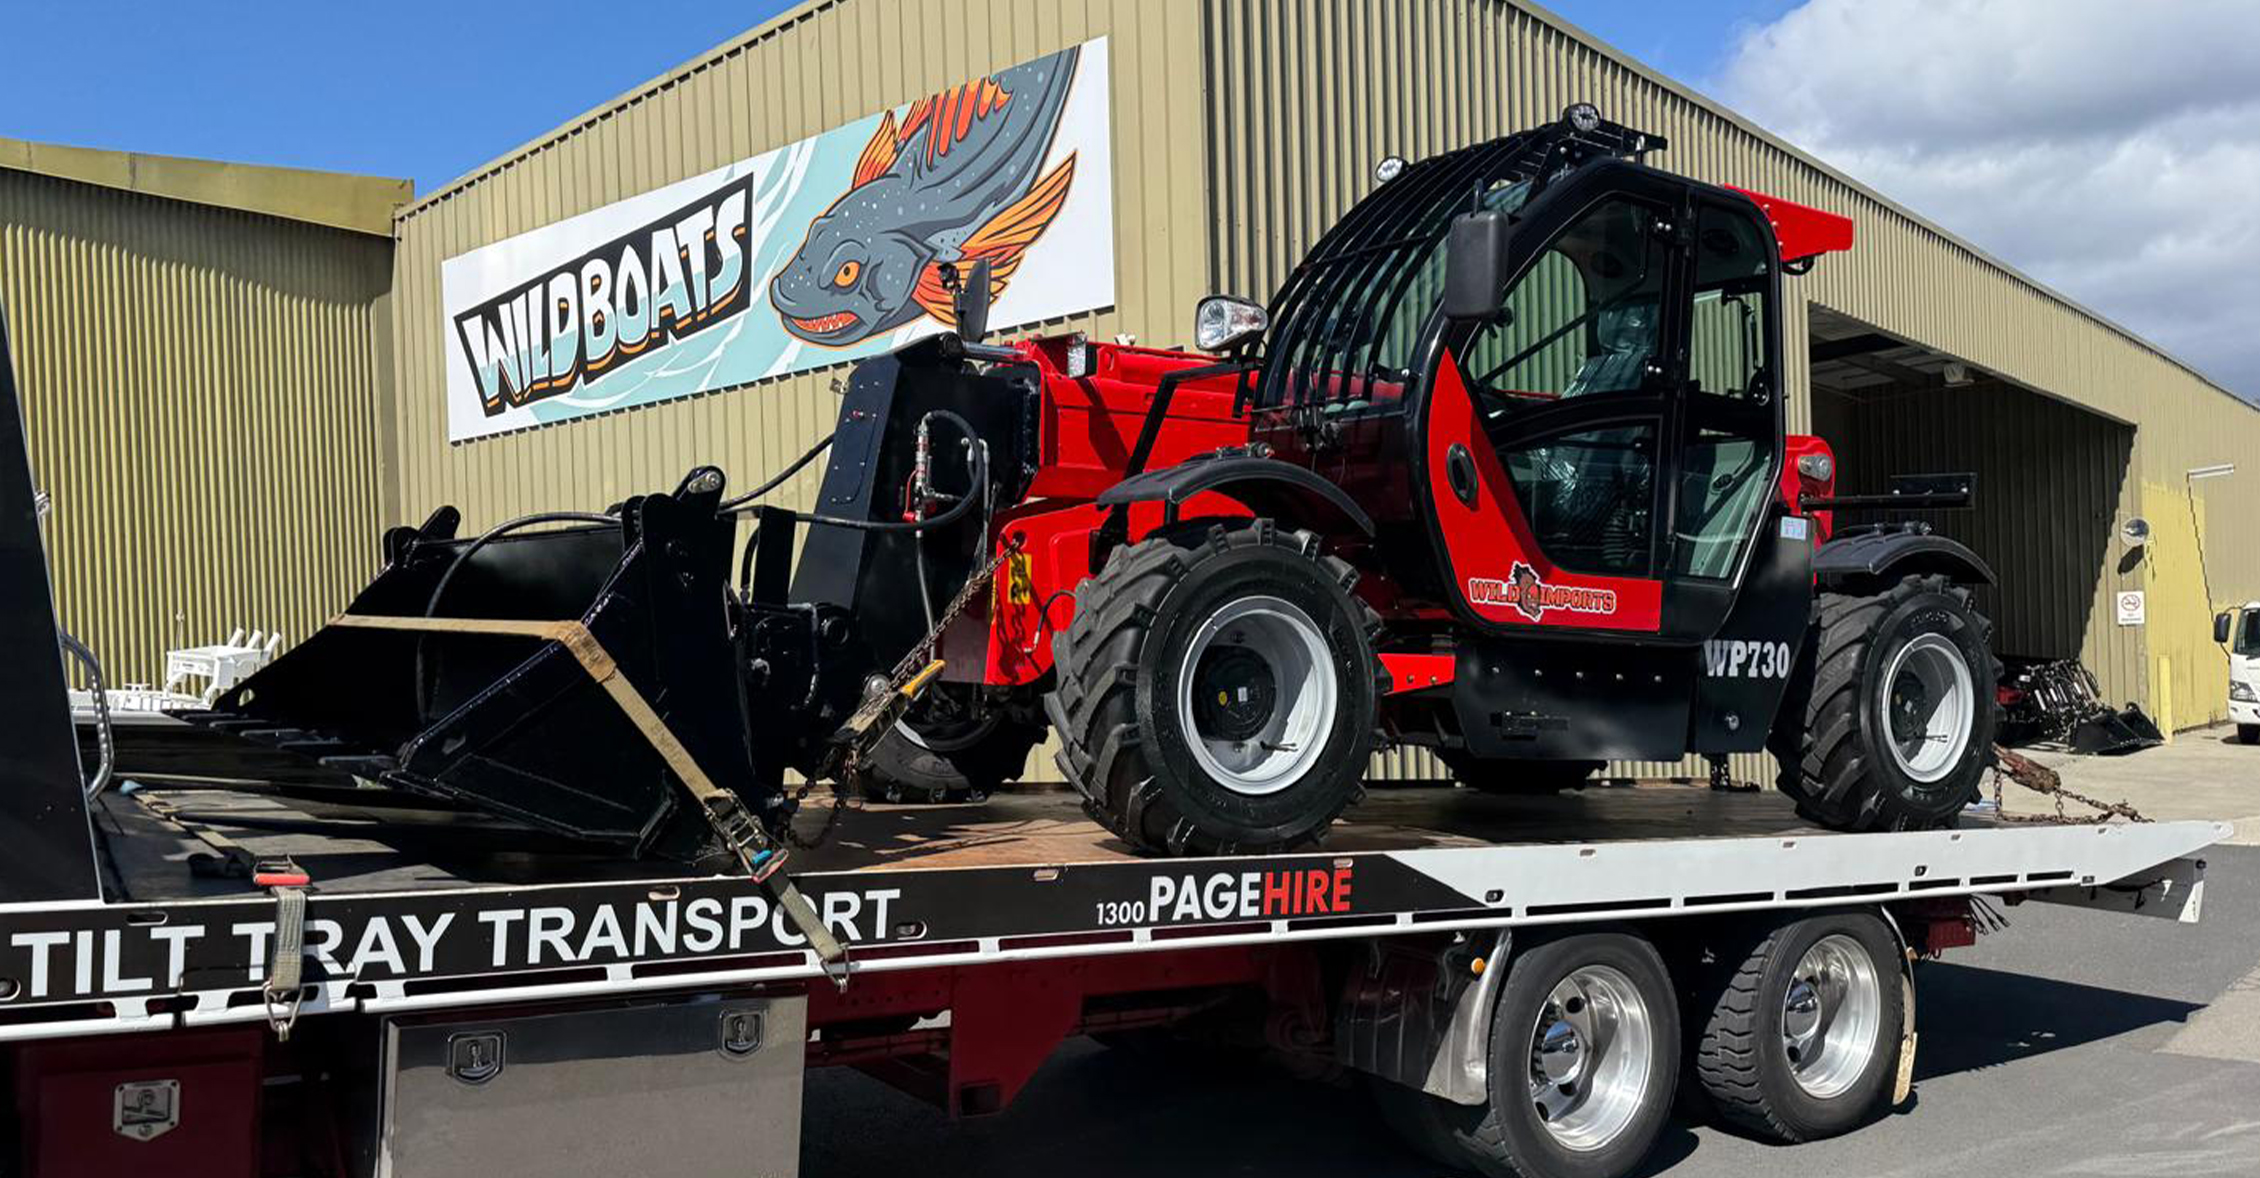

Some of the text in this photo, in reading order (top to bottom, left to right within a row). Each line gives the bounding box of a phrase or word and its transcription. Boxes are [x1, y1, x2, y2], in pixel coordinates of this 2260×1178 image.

[460, 187, 747, 408] WILDBOATS
[1470, 579, 1615, 613] WILD IMPORTS
[1703, 639, 1790, 679] WP730
[1096, 867, 1354, 926] 1300 PAGEHIRE
[11, 925, 206, 997] TILT
[232, 912, 456, 982] TRAY
